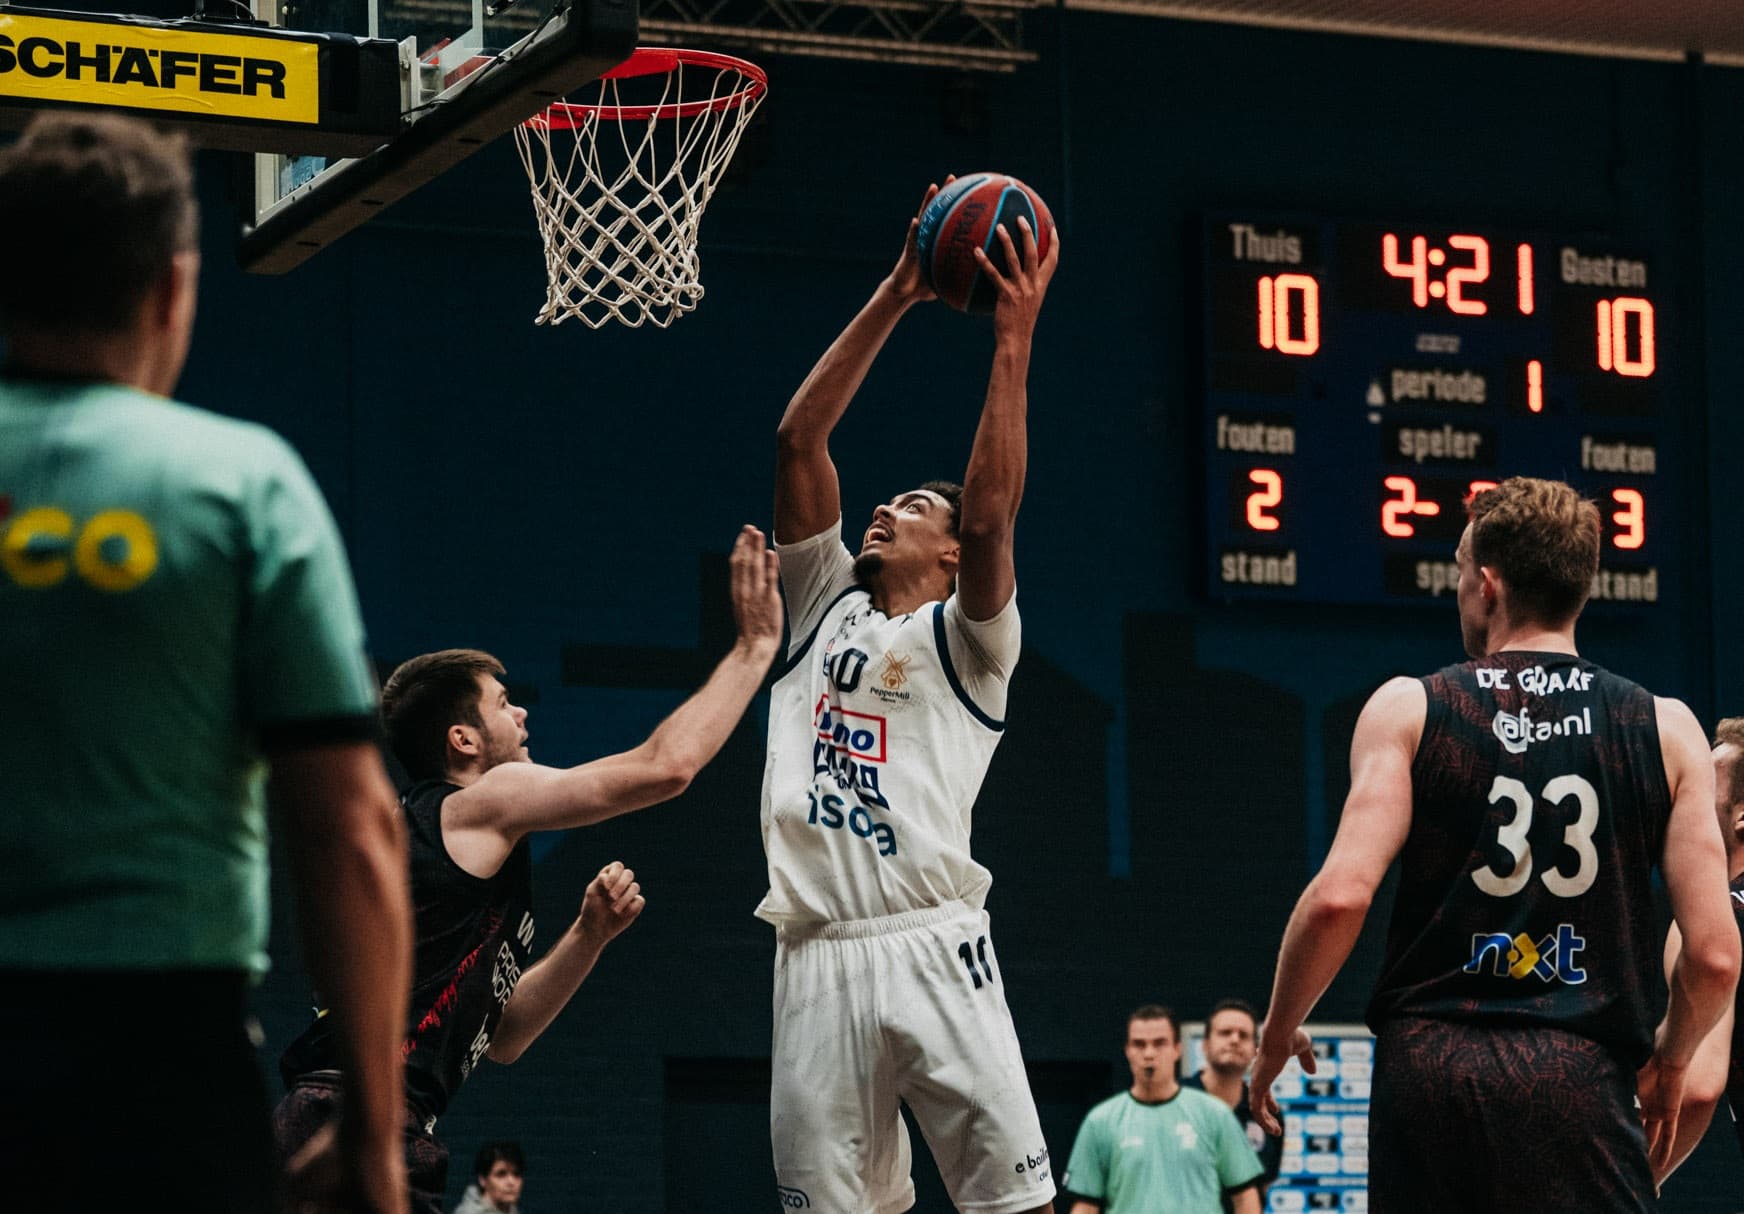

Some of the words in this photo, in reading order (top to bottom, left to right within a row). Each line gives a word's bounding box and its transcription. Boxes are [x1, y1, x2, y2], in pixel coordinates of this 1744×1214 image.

[1230, 224, 1301, 263] Thuis
[1560, 247, 1646, 288] Gasten
[1258, 273, 1319, 356] 10
[1597, 297, 1655, 377] 10
[1391, 370, 1486, 403] periode
[1527, 360, 1542, 413] 1
[1217, 416, 1295, 454] fouten
[1399, 425, 1481, 462] speler
[1581, 436, 1656, 474] fouten
[1246, 469, 1282, 531] 2
[1612, 488, 1645, 550] 3
[1222, 552, 1297, 587] stand
[1416, 560, 1459, 596] spe
[1476, 667, 1511, 690] DE
[1517, 665, 1594, 697] GRAAF
[1471, 774, 1600, 897] 33
